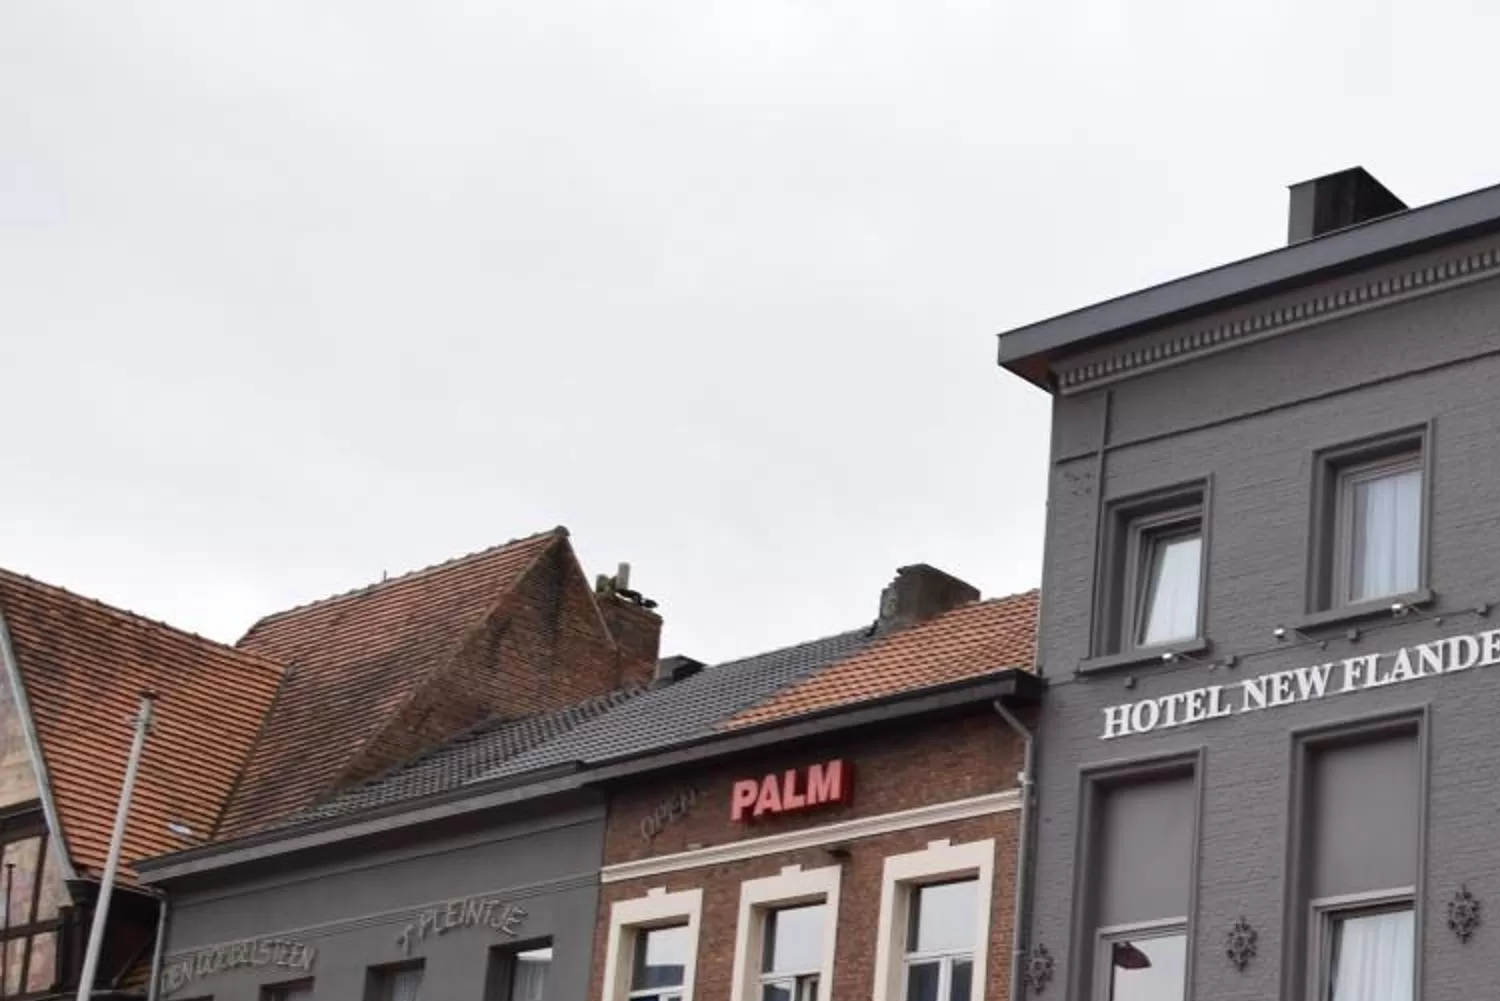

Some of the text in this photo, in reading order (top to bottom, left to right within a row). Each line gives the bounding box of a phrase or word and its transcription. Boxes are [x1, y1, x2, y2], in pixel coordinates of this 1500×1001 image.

[1100, 684, 1231, 740] HOTEL
[1240, 662, 1334, 713] NEW
[730, 760, 843, 822] PALM
